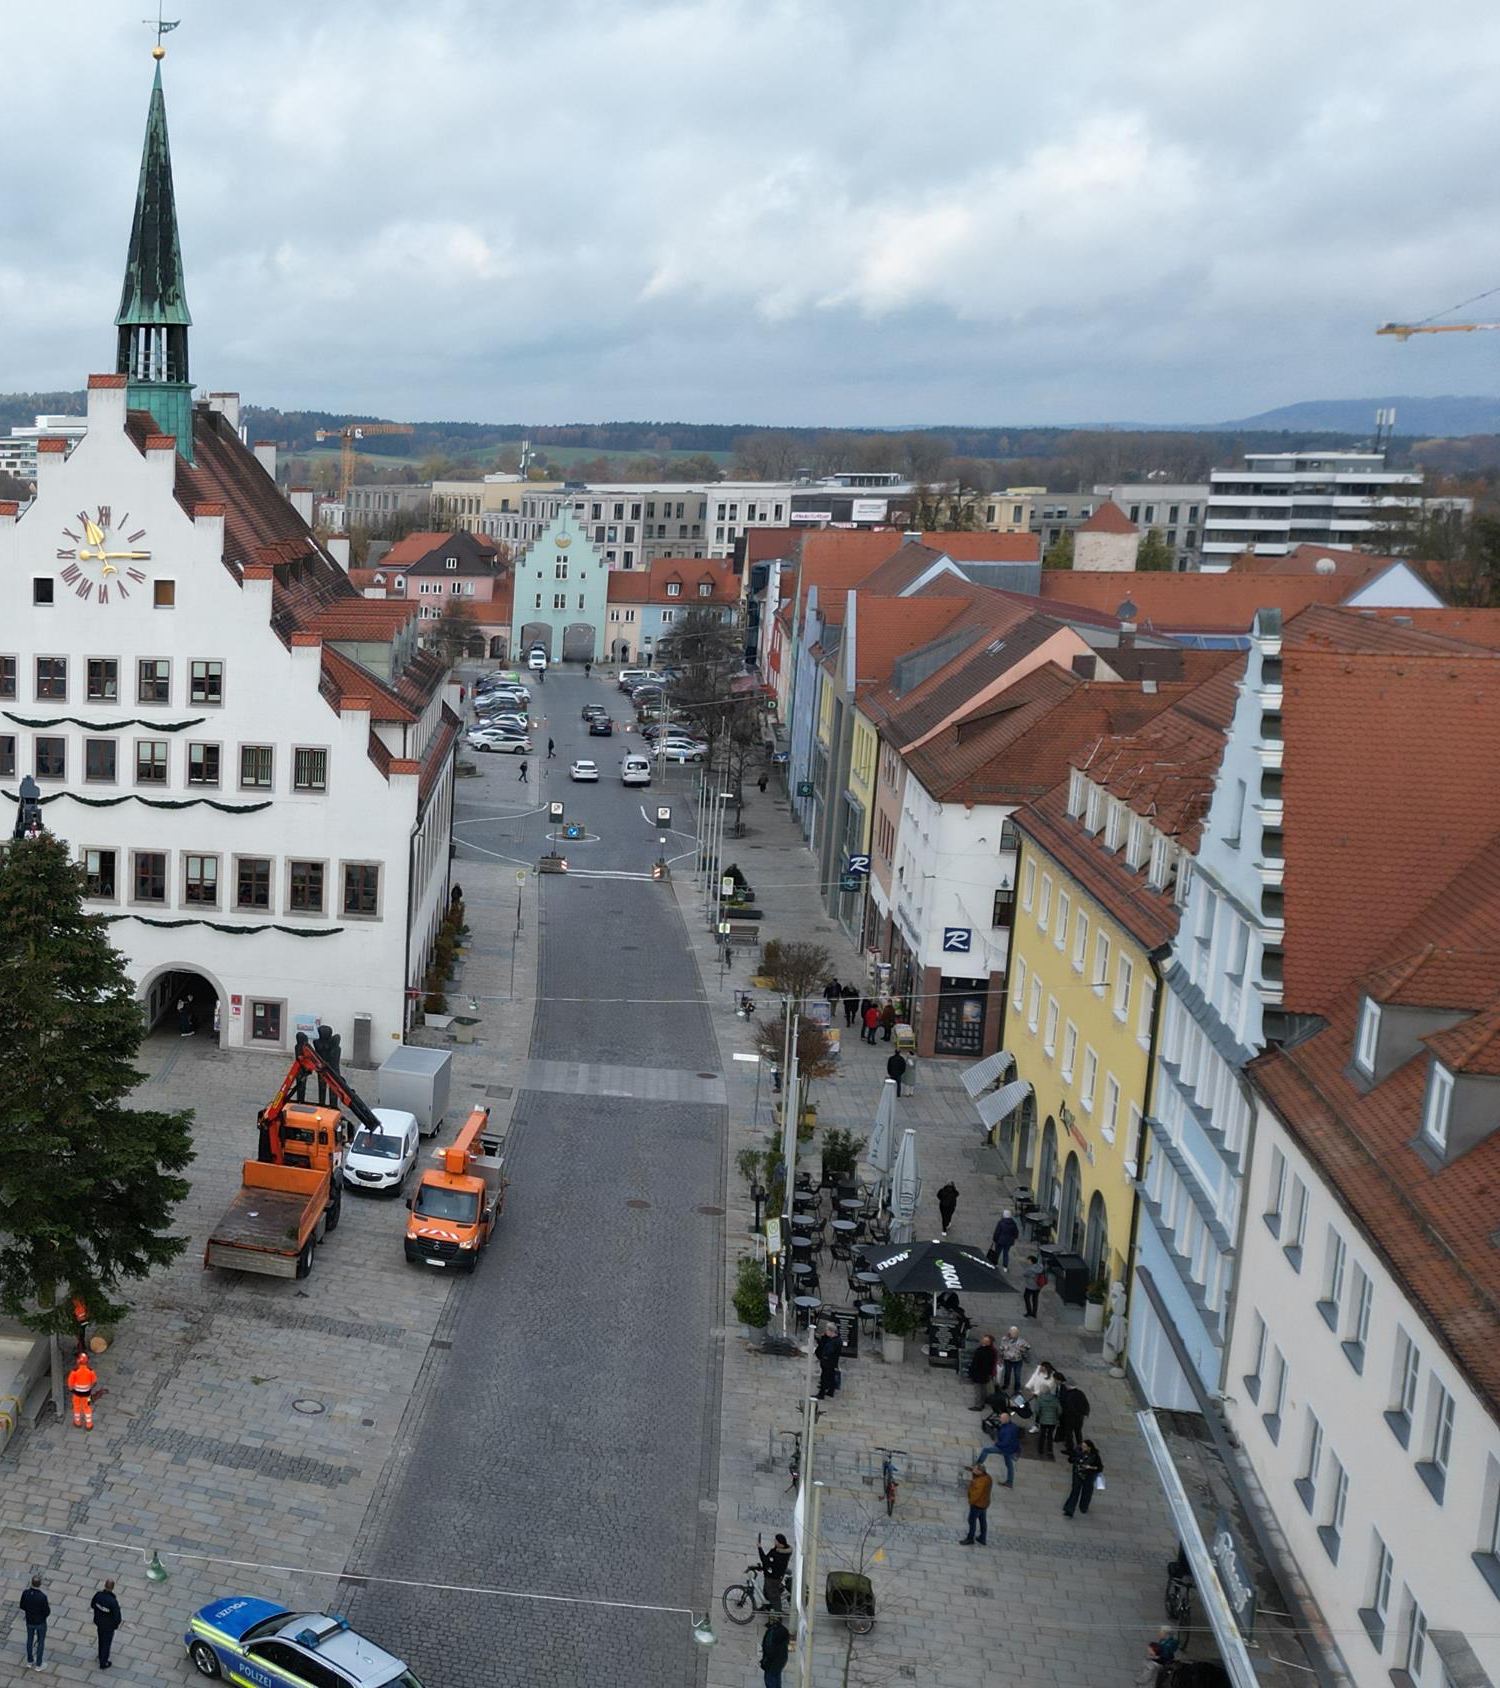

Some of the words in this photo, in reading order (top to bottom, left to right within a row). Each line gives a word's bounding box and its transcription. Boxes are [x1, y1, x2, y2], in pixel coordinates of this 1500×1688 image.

[97, 505, 111, 527] XII
[117, 512, 129, 530] I
[62, 527, 82, 543] X
[127, 528, 147, 543] II
[56, 548, 77, 559] IX
[116, 580, 130, 599] V
[940, 1262, 963, 1289] now
[239, 1663, 272, 1688] POLIZEI
